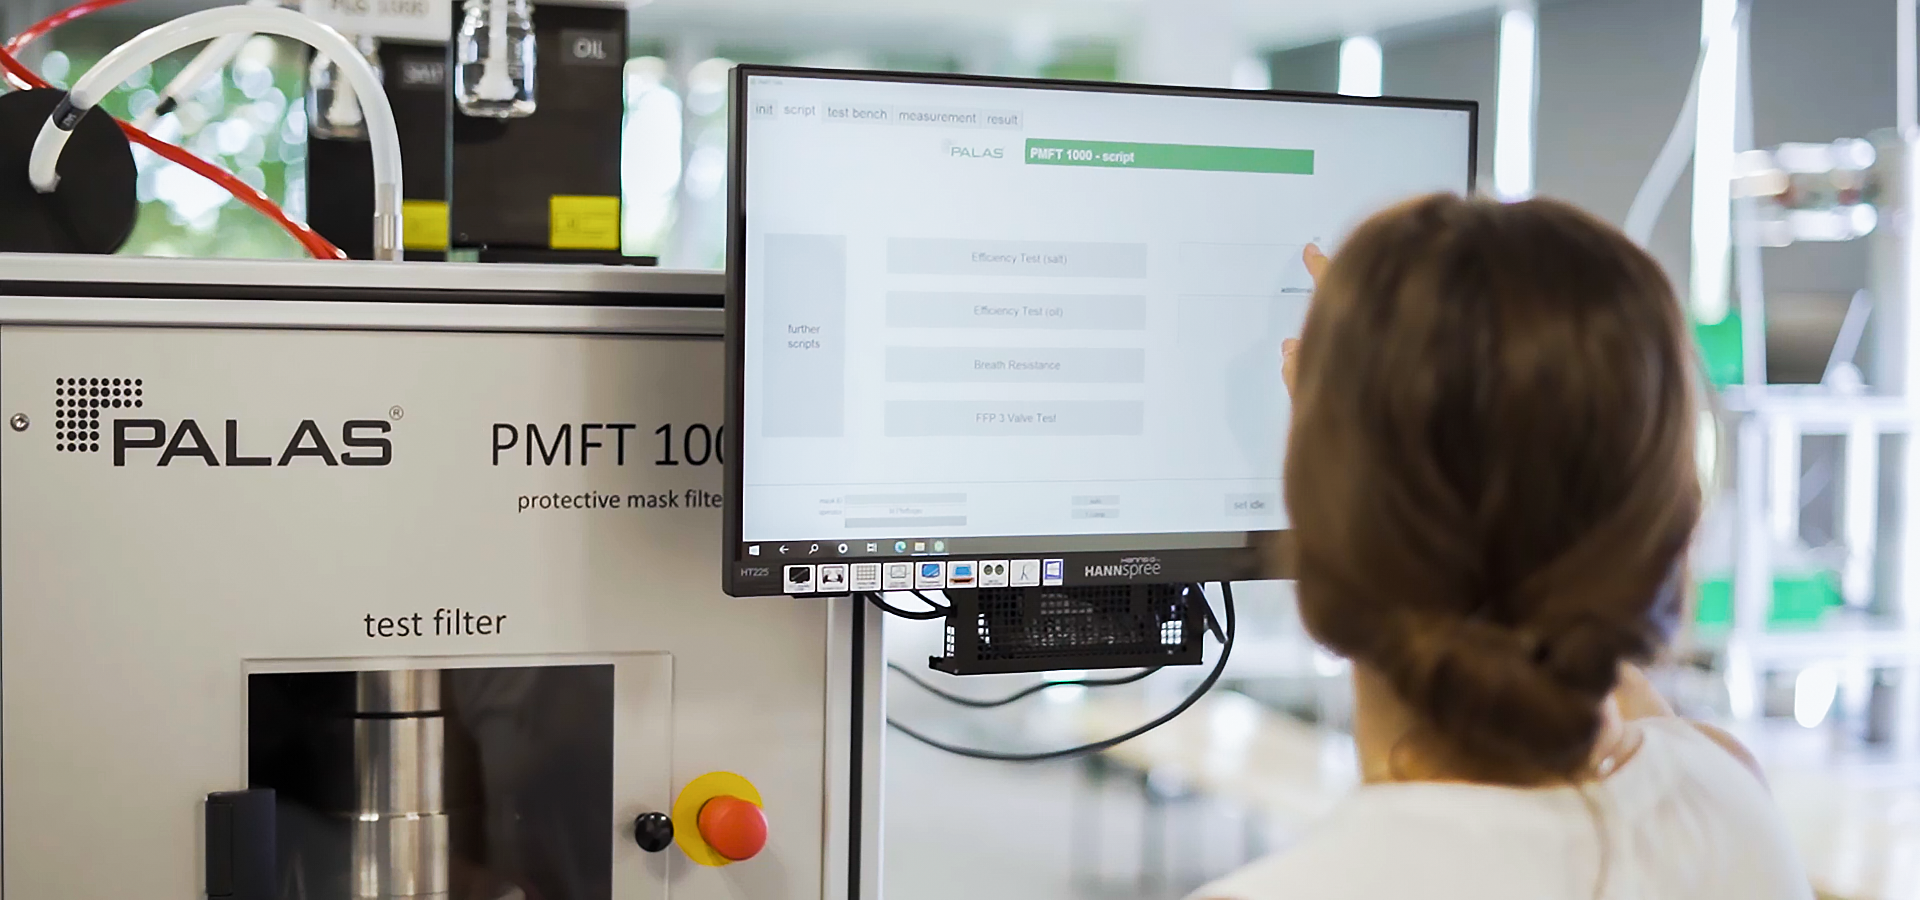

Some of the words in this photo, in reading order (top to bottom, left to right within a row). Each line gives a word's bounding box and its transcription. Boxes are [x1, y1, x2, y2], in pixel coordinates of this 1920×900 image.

[573, 38, 607, 60] OIL
[755, 103, 774, 116] init
[783, 104, 817, 118] script
[827, 106, 849, 119] test
[852, 107, 888, 121] bench
[898, 110, 977, 125] measurement
[986, 113, 1018, 127] result
[950, 145, 1004, 160] PALAS
[1030, 147, 1063, 160] PMFT
[1066, 149, 1093, 161] 1000
[1102, 151, 1135, 164] script
[971, 251, 1018, 265] Efficiency
[1020, 252, 1041, 264] Test
[973, 304, 1020, 318] Efficiency
[1023, 305, 1043, 317] Test
[787, 323, 821, 335] further
[787, 338, 821, 350] scripts
[974, 359, 1006, 371] Breath
[1008, 359, 1061, 371] Resistance
[975, 412, 997, 423] FFP
[999, 412, 1006, 423] 3
[1007, 412, 1034, 424] Valve
[1036, 412, 1057, 423] Test
[112, 419, 393, 467] PALAS
[491, 422, 637, 467] PMFT
[518, 490, 621, 514] protective
[627, 490, 679, 509] mask
[740, 567, 770, 577] HT225
[1083, 562, 1161, 579] HANNspree
[363, 611, 422, 639] test
[434, 607, 507, 637] filter
